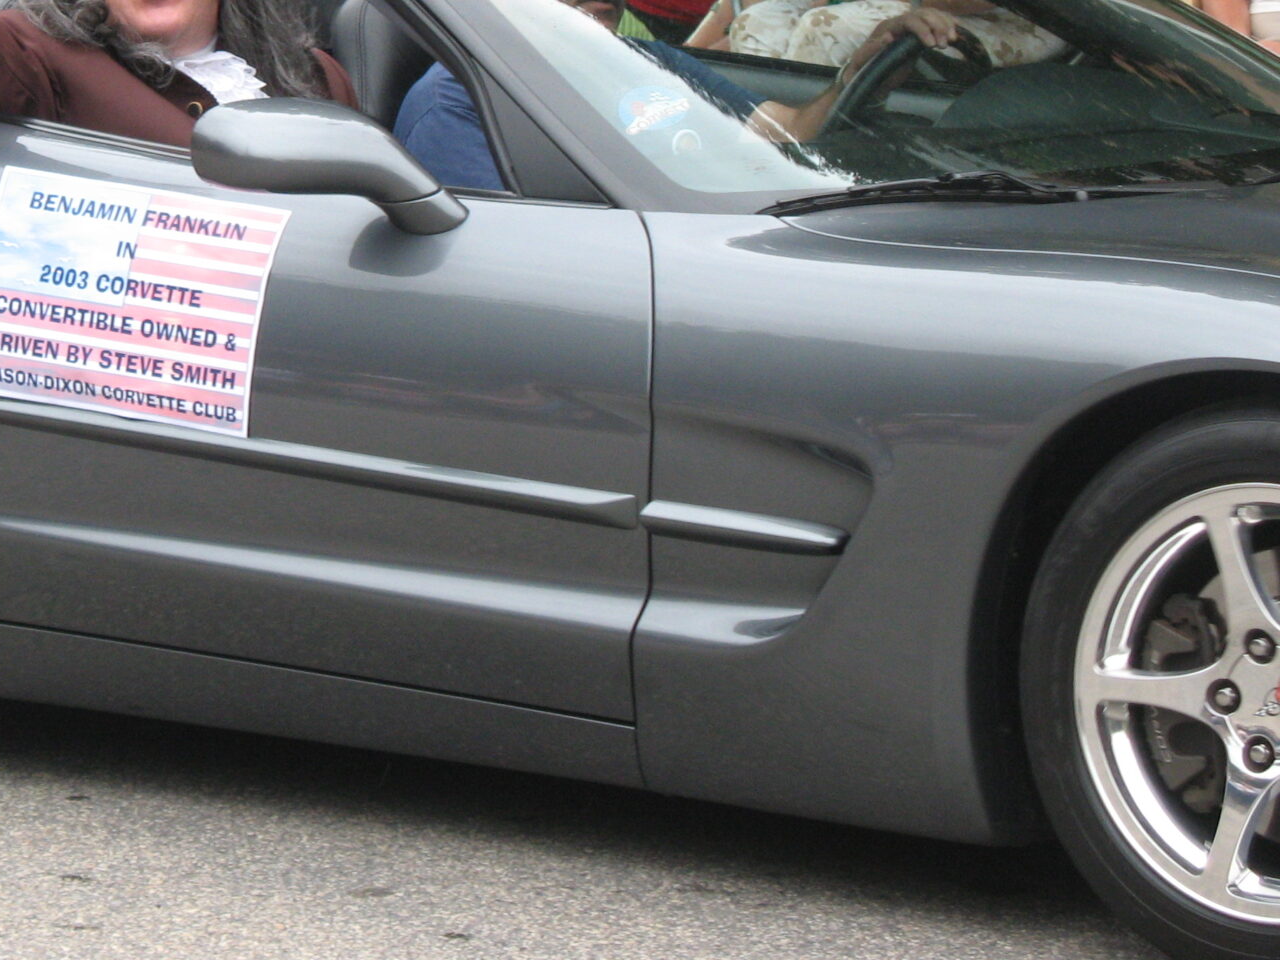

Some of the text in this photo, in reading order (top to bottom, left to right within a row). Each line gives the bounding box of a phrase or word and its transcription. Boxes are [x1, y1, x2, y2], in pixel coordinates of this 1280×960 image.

[29, 191, 247, 241] BENJAMIN FRANKLIN
[116, 241, 138, 260] IN
[39, 264, 204, 308] 2003 CORVETTE
[140, 318, 218, 348] OWNED
[224, 333, 237, 352] &
[66, 344, 93, 366] BY
[99, 350, 165, 378] STEVE
[171, 362, 236, 390] SMITH
[102, 385, 188, 414] CORVETTE
[192, 401, 237, 423] CLUB
